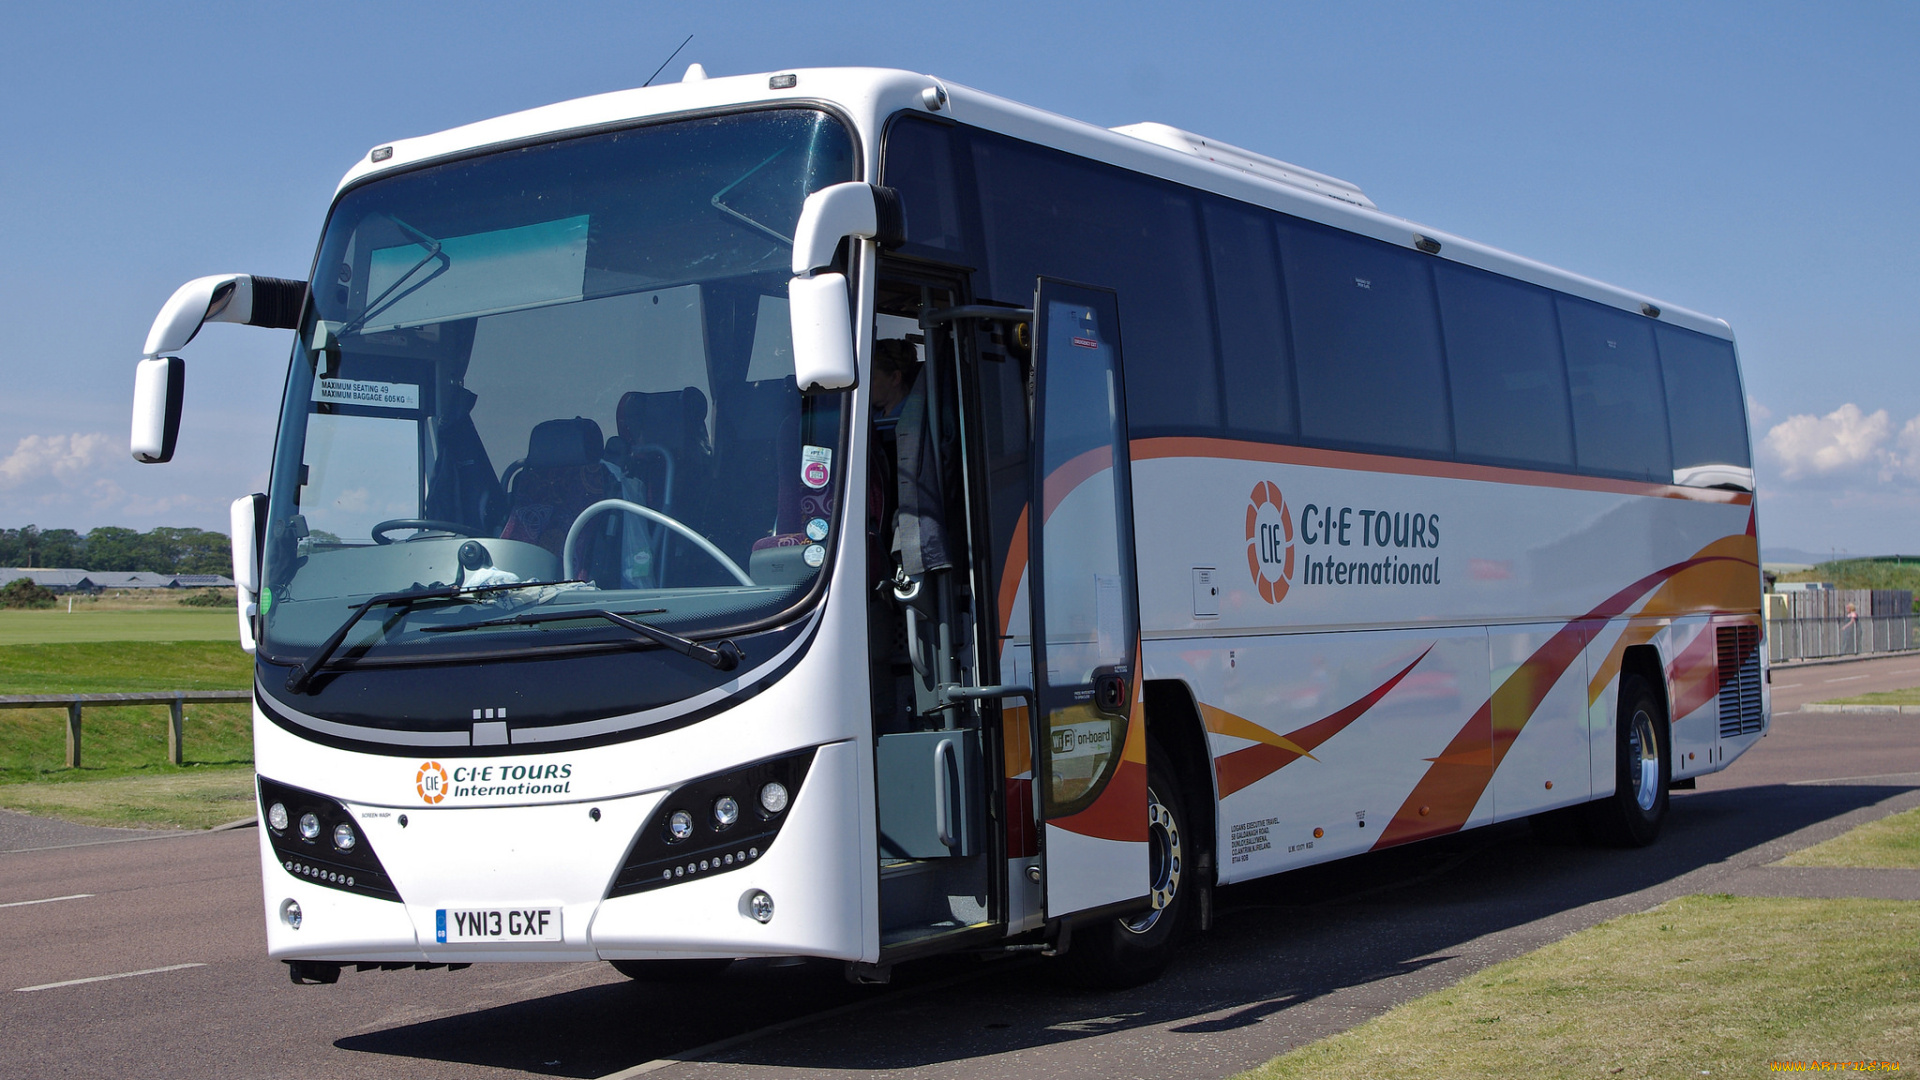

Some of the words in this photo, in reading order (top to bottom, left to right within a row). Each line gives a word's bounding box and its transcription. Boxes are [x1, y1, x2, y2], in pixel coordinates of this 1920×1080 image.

[321, 381, 352, 391] MAXIMUM
[353, 384, 379, 393] SEATING
[380, 386, 389, 394] 49
[321, 390, 352, 399] MAXIMUM
[353, 392, 382, 402] BAGGAGE
[1358, 509, 1440, 549] TOURS
[1261, 523, 1282, 564] CIE
[1303, 554, 1441, 585] International
[1077, 727, 1110, 745] on-board
[499, 763, 572, 781] TOURS
[425, 775, 439, 791] CIE
[454, 781, 571, 797] International
[454, 911, 502, 936] YN13
[508, 910, 551, 936] GXF
[437, 930, 446, 938] GB
